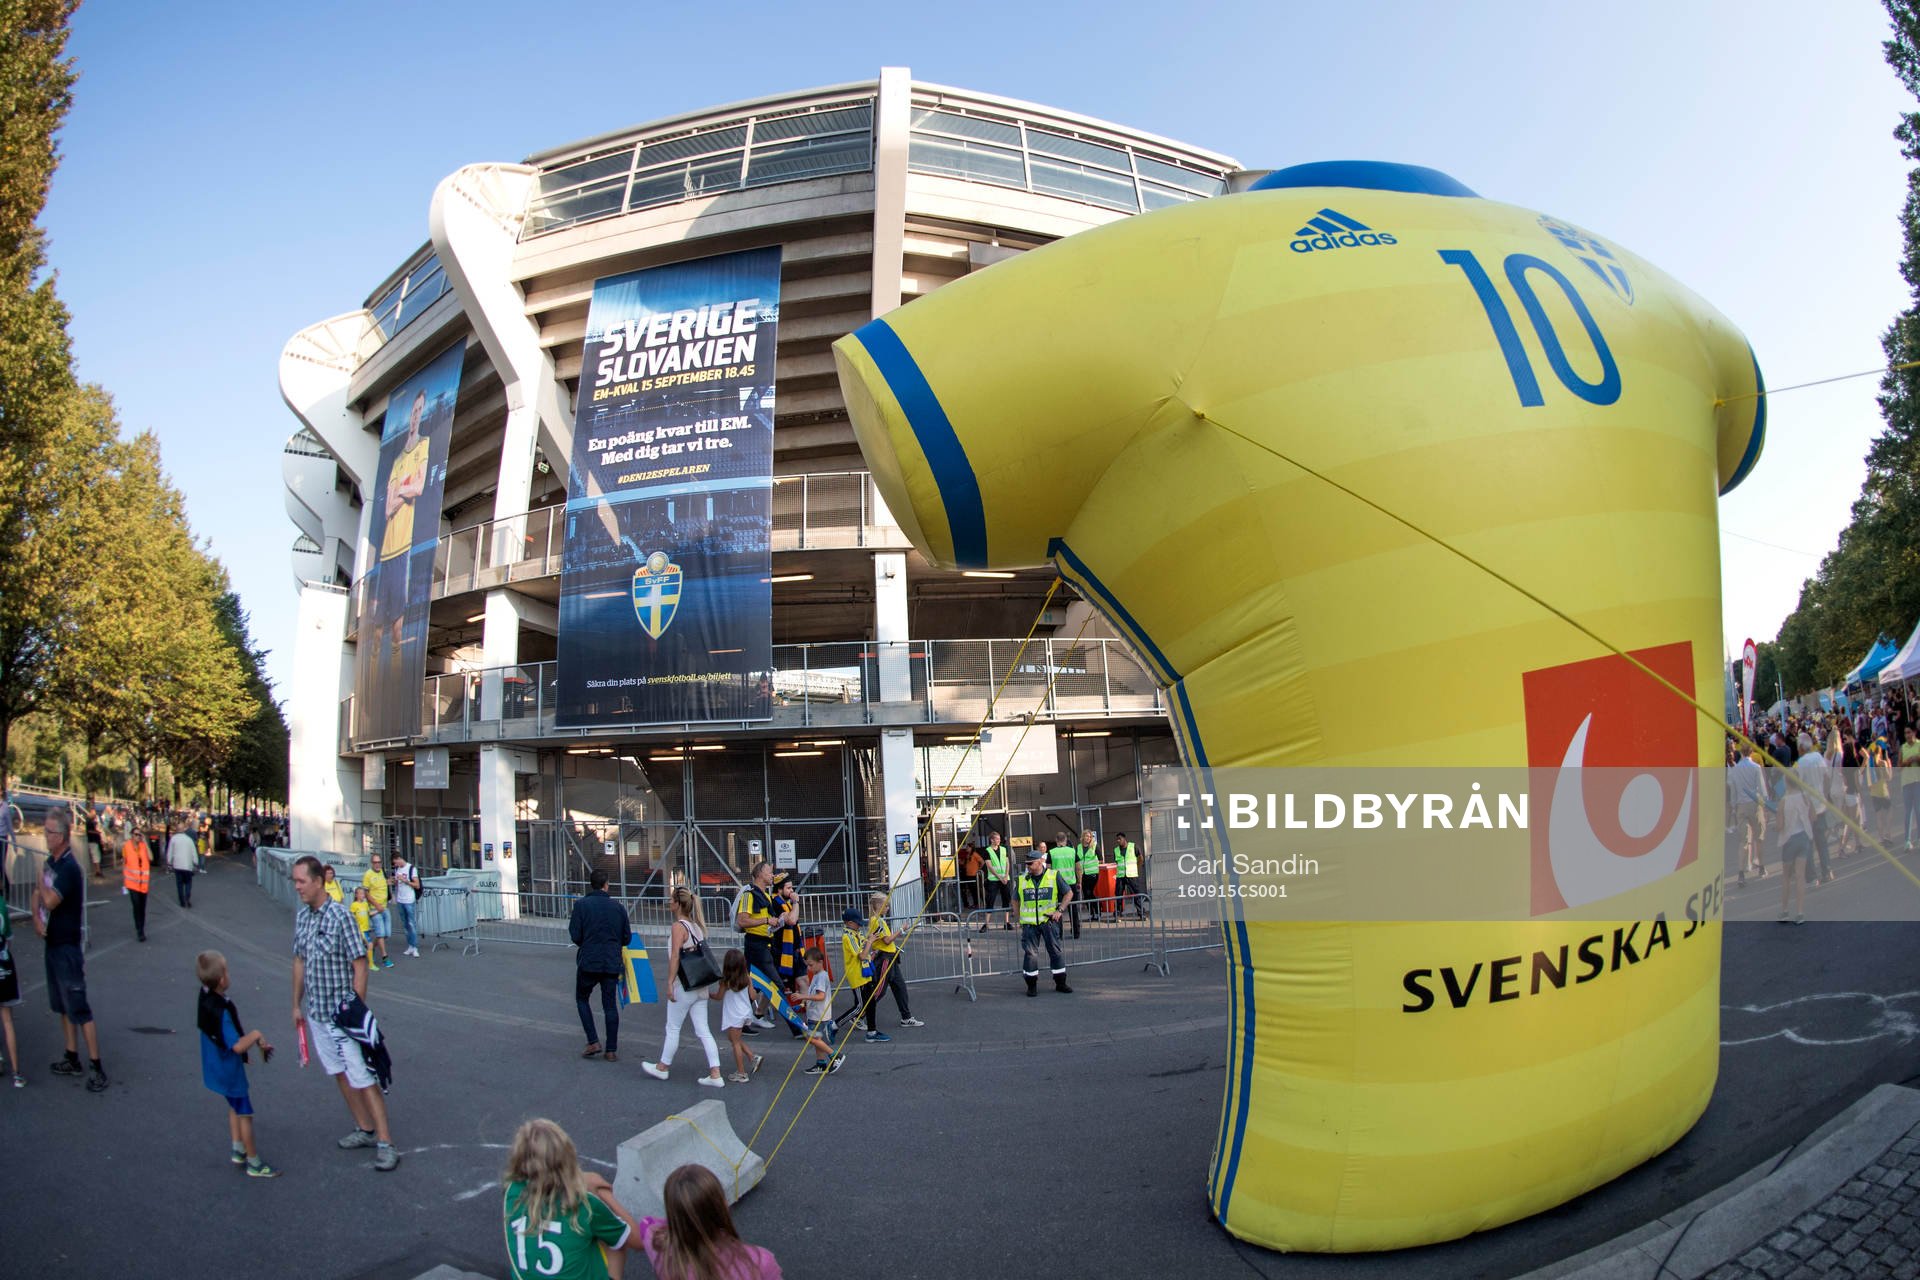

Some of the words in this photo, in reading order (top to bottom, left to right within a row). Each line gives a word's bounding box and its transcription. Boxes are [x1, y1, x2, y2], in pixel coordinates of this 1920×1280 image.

[1289, 231, 1398, 253] adidas
[600, 298, 760, 358] SVERIGE
[1437, 250, 1622, 408] 10
[595, 334, 758, 387] SLOVAKIEN
[593, 382, 639, 401] EM-KVAL
[641, 379, 653, 391] 15
[654, 368, 723, 389] SEPTEMBER
[725, 364, 755, 379] 18.45
[588, 437, 607, 451] En
[608, 430, 654, 450] poäng
[656, 425, 693, 439] kvar
[695, 418, 719, 433] till
[720, 416, 752, 431] EM.
[601, 449, 633, 466] Med
[635, 445, 660, 460] dig
[661, 442, 686, 455] tar
[686, 438, 703, 451] vi
[705, 437, 733, 449] tre.
[586, 680, 606, 688] Säkra
[607, 679, 618, 687] din
[619, 677, 636, 687] plats
[637, 676, 647, 686] på
[427, 750, 434, 766] 4
[1402, 911, 1671, 1013] SVENSKA
[1684, 874, 1722, 939] SPE
[511, 1216, 564, 1275] 15
